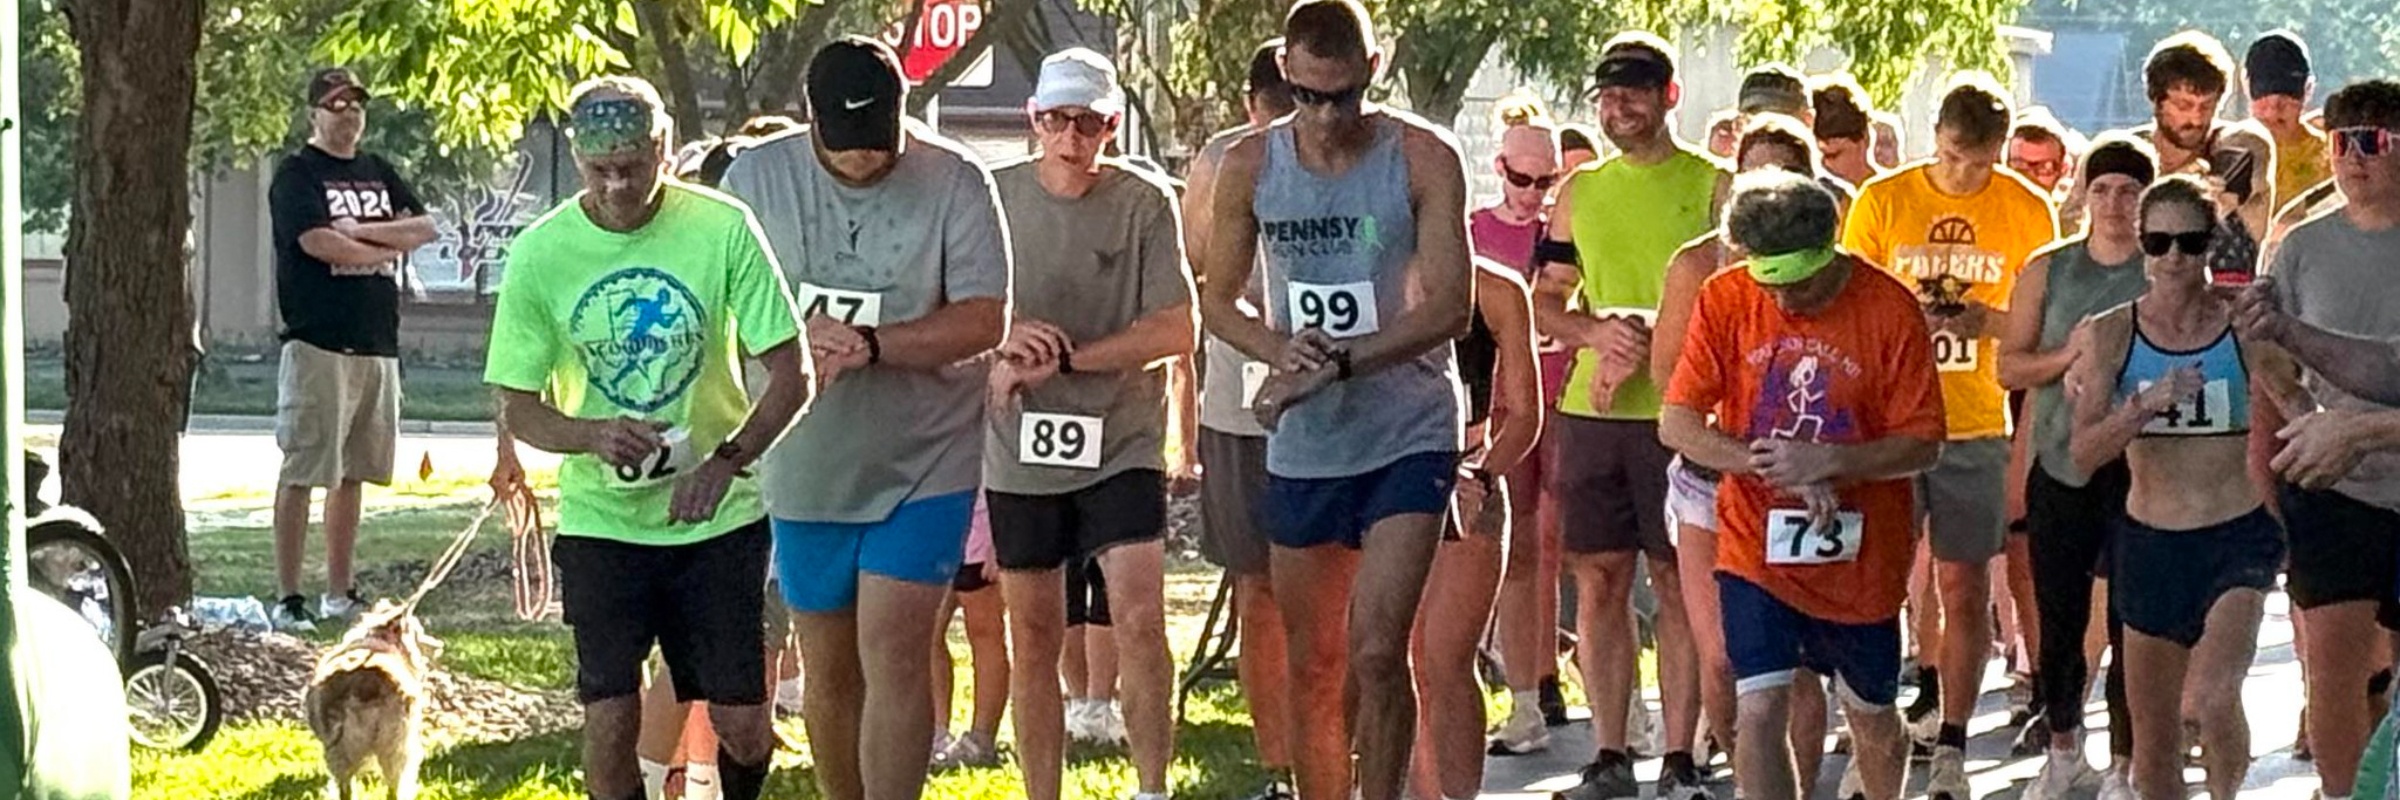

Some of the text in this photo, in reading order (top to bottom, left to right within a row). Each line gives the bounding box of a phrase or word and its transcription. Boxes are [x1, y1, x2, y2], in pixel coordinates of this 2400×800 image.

[1264, 216, 1360, 241] PENNSY
[1300, 290, 1359, 331] 99
[1032, 419, 1085, 460] 89
[1785, 516, 1843, 557] 73
